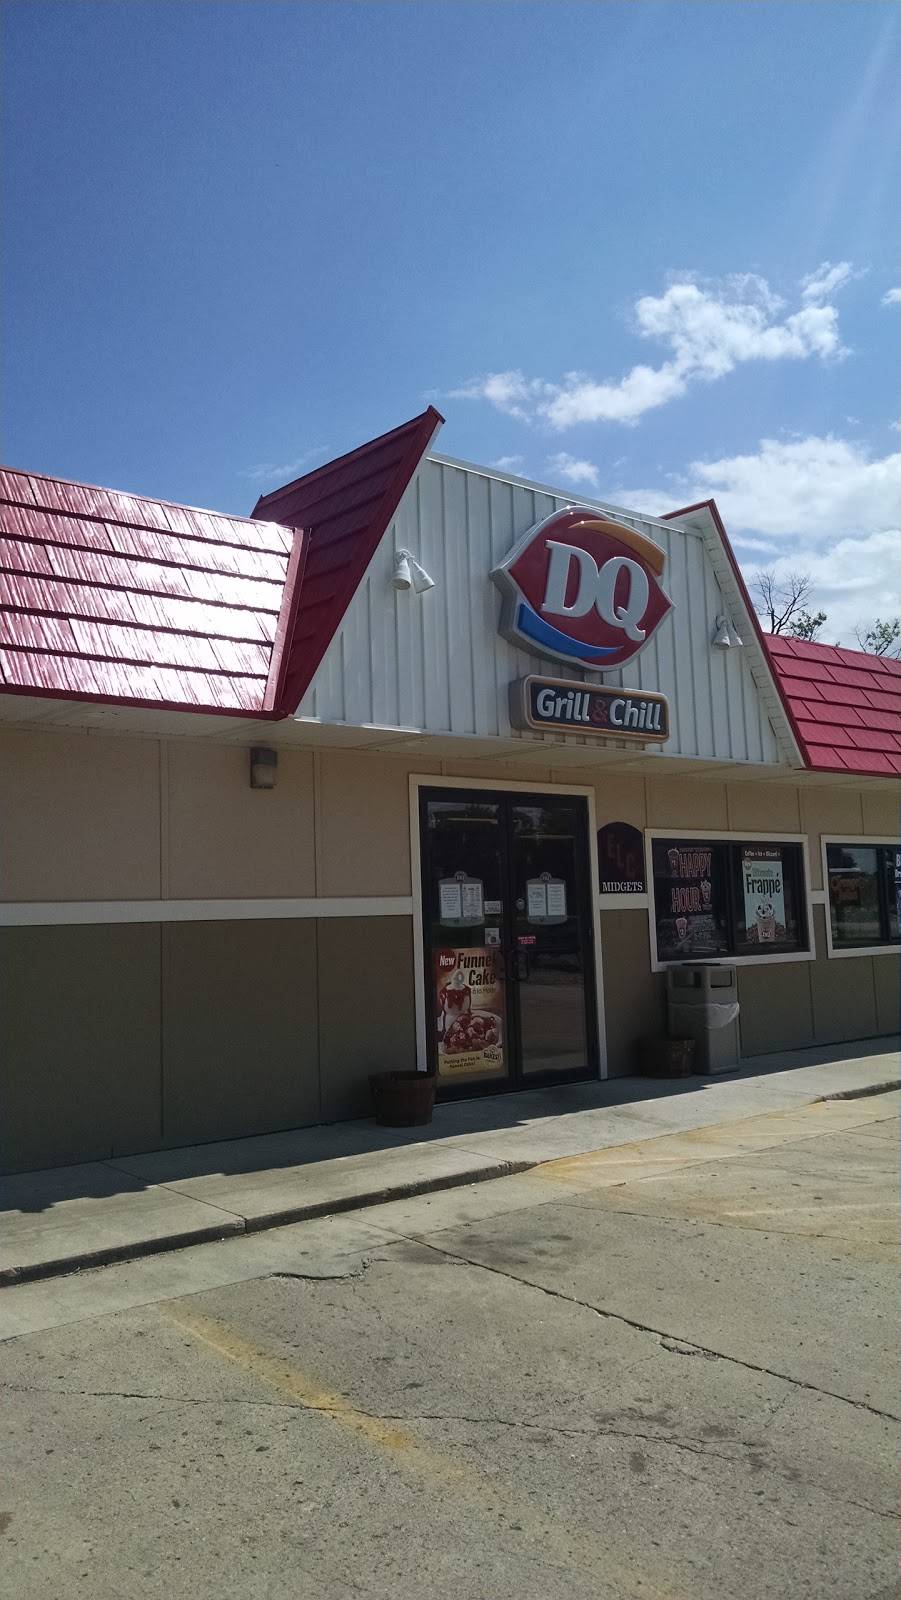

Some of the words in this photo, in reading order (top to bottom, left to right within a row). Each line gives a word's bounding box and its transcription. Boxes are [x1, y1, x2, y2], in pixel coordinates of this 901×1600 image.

[541, 539, 649, 641] DQ
[536, 688, 590, 722] Grill
[592, 698, 608, 723] &
[609, 699, 662, 731] Chill
[679, 852, 712, 878] HAPPY
[602, 881, 643, 892] MIDGETS
[671, 886, 702, 912] HOUR
[439, 955, 455, 967] New
[457, 952, 496, 969] Funnel
[468, 968, 497, 986] Cake
